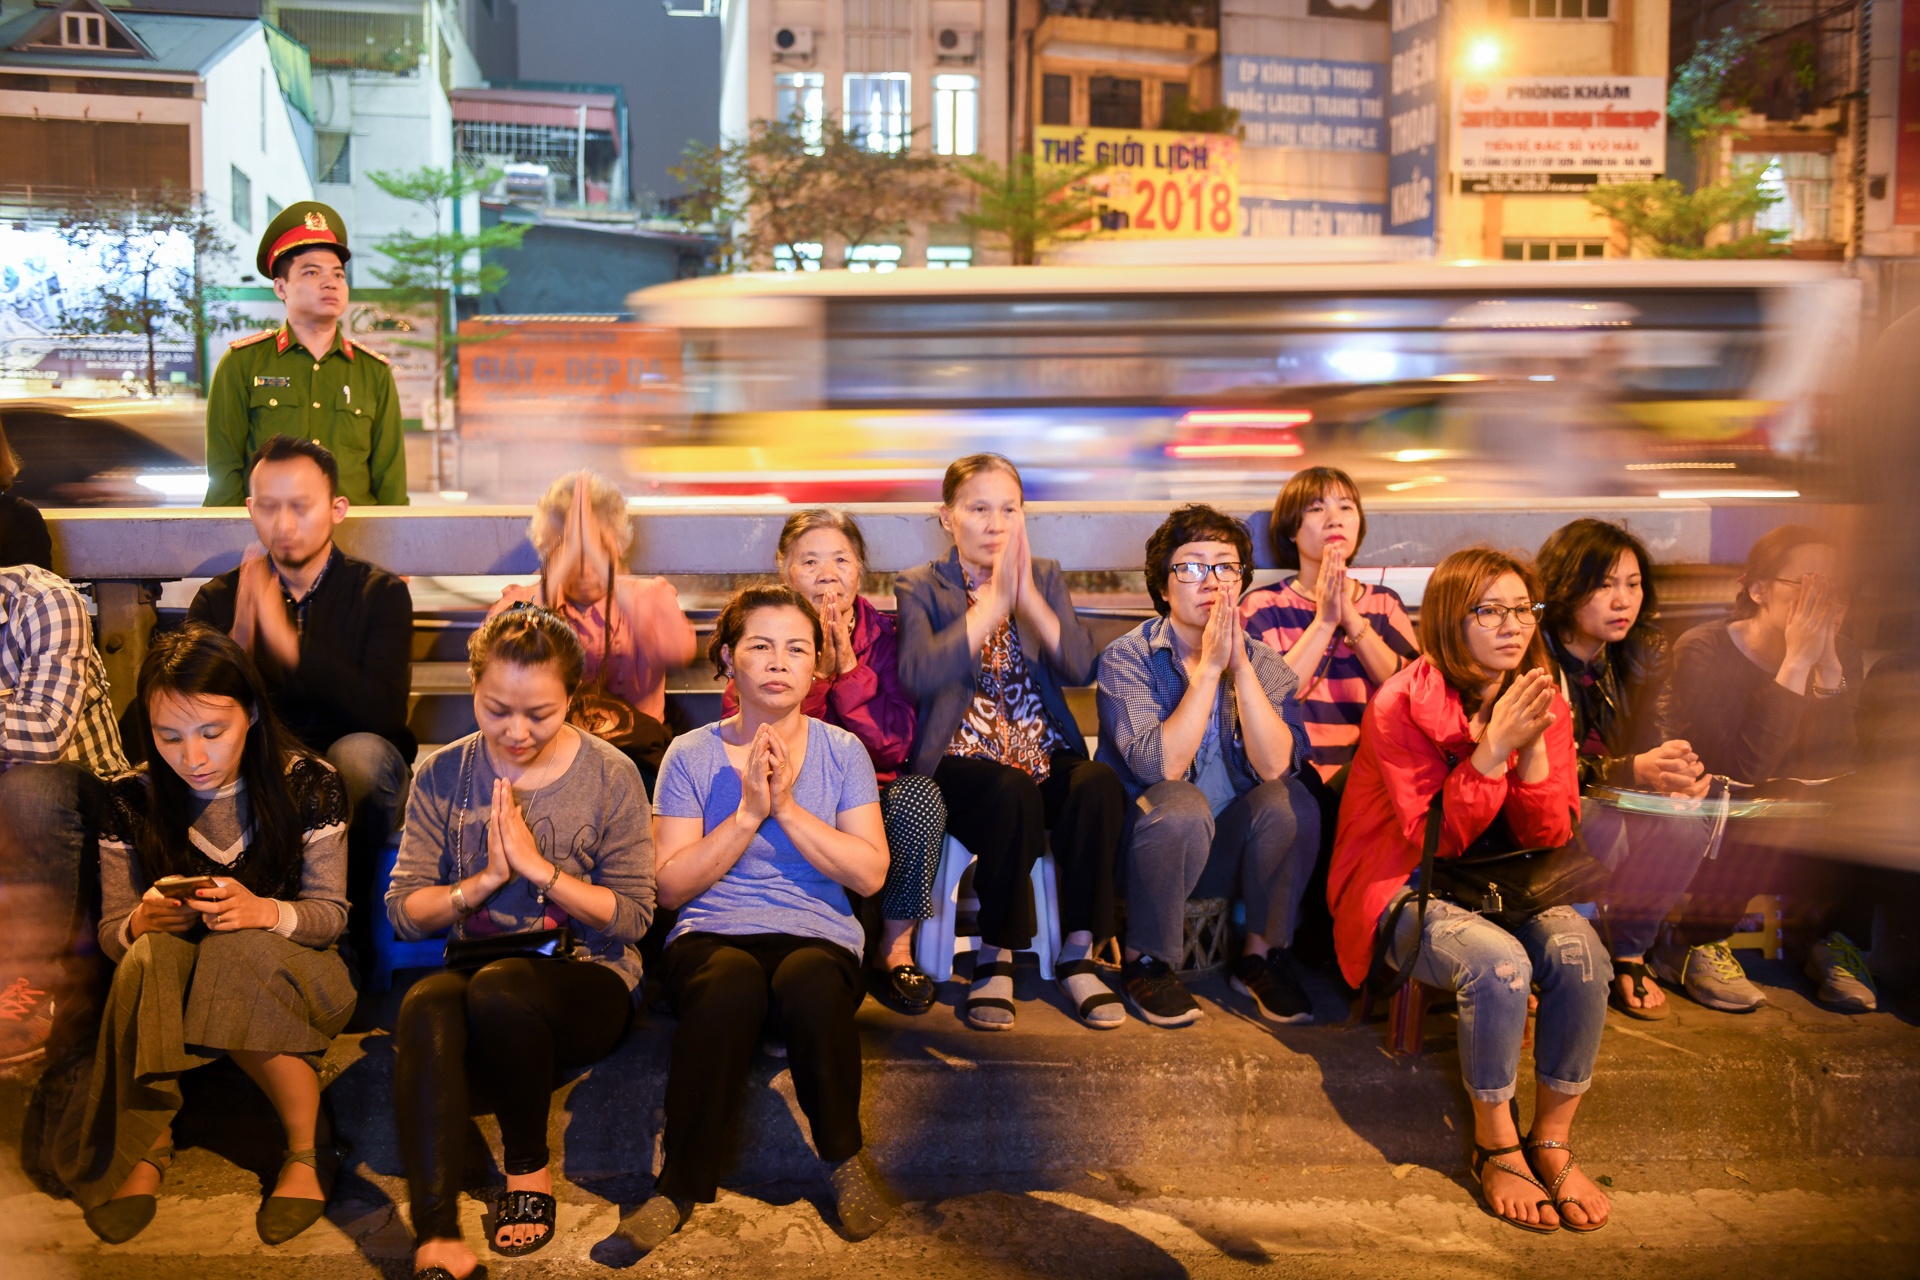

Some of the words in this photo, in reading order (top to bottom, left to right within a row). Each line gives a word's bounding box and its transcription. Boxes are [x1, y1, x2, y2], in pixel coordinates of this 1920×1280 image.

[1573, 80, 1631, 99] KHÁM
[1155, 144, 1208, 174] LỊCH
[1134, 179, 1232, 233] 2018
